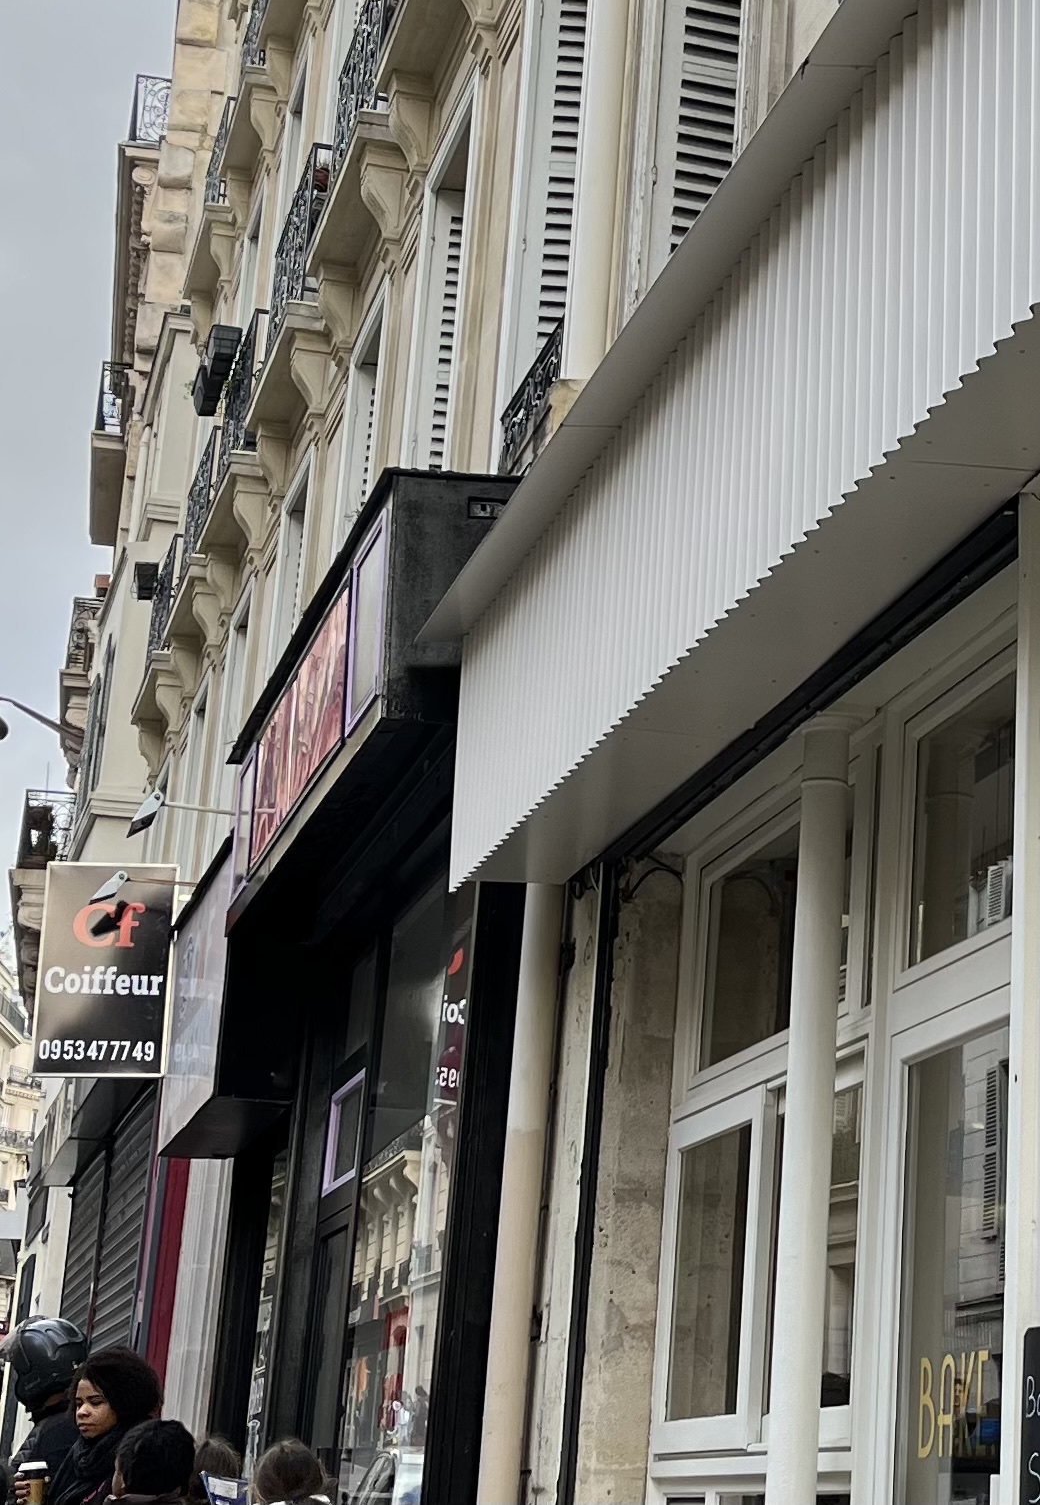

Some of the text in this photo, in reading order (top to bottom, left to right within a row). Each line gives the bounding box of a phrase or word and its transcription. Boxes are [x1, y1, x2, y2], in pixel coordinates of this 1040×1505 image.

[73, 901, 145, 949] Cf
[44, 965, 164, 996] Coiffeur
[38, 1039, 156, 1062] 0953477749
